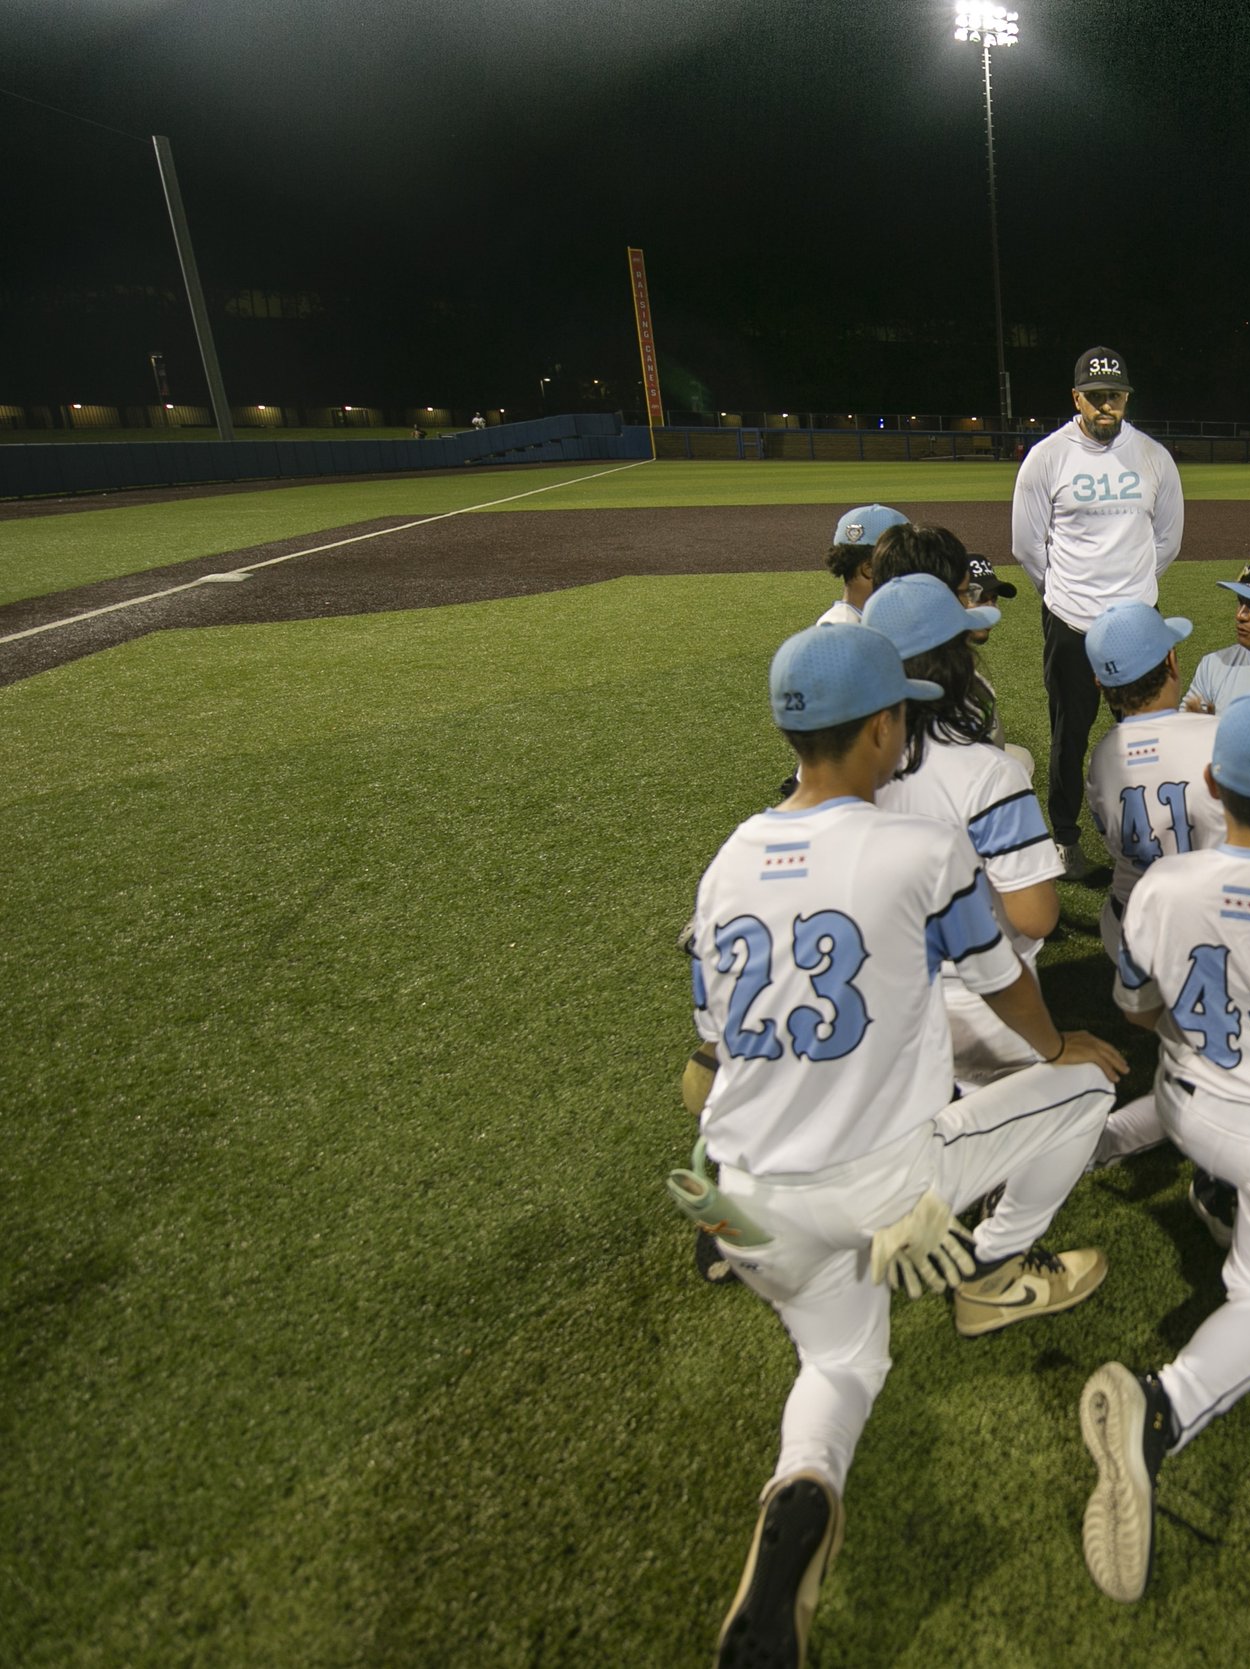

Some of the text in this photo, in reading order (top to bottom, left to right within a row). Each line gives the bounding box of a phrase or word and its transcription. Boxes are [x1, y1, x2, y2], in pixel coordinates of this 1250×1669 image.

[636, 271, 649, 338] RAISING
[1090, 358, 1121, 374] 312
[1072, 471, 1142, 502] 312
[1104, 661, 1119, 675] 41
[783, 692, 806, 711] 23
[1119, 781, 1194, 869] 41
[714, 909, 874, 1062] 23
